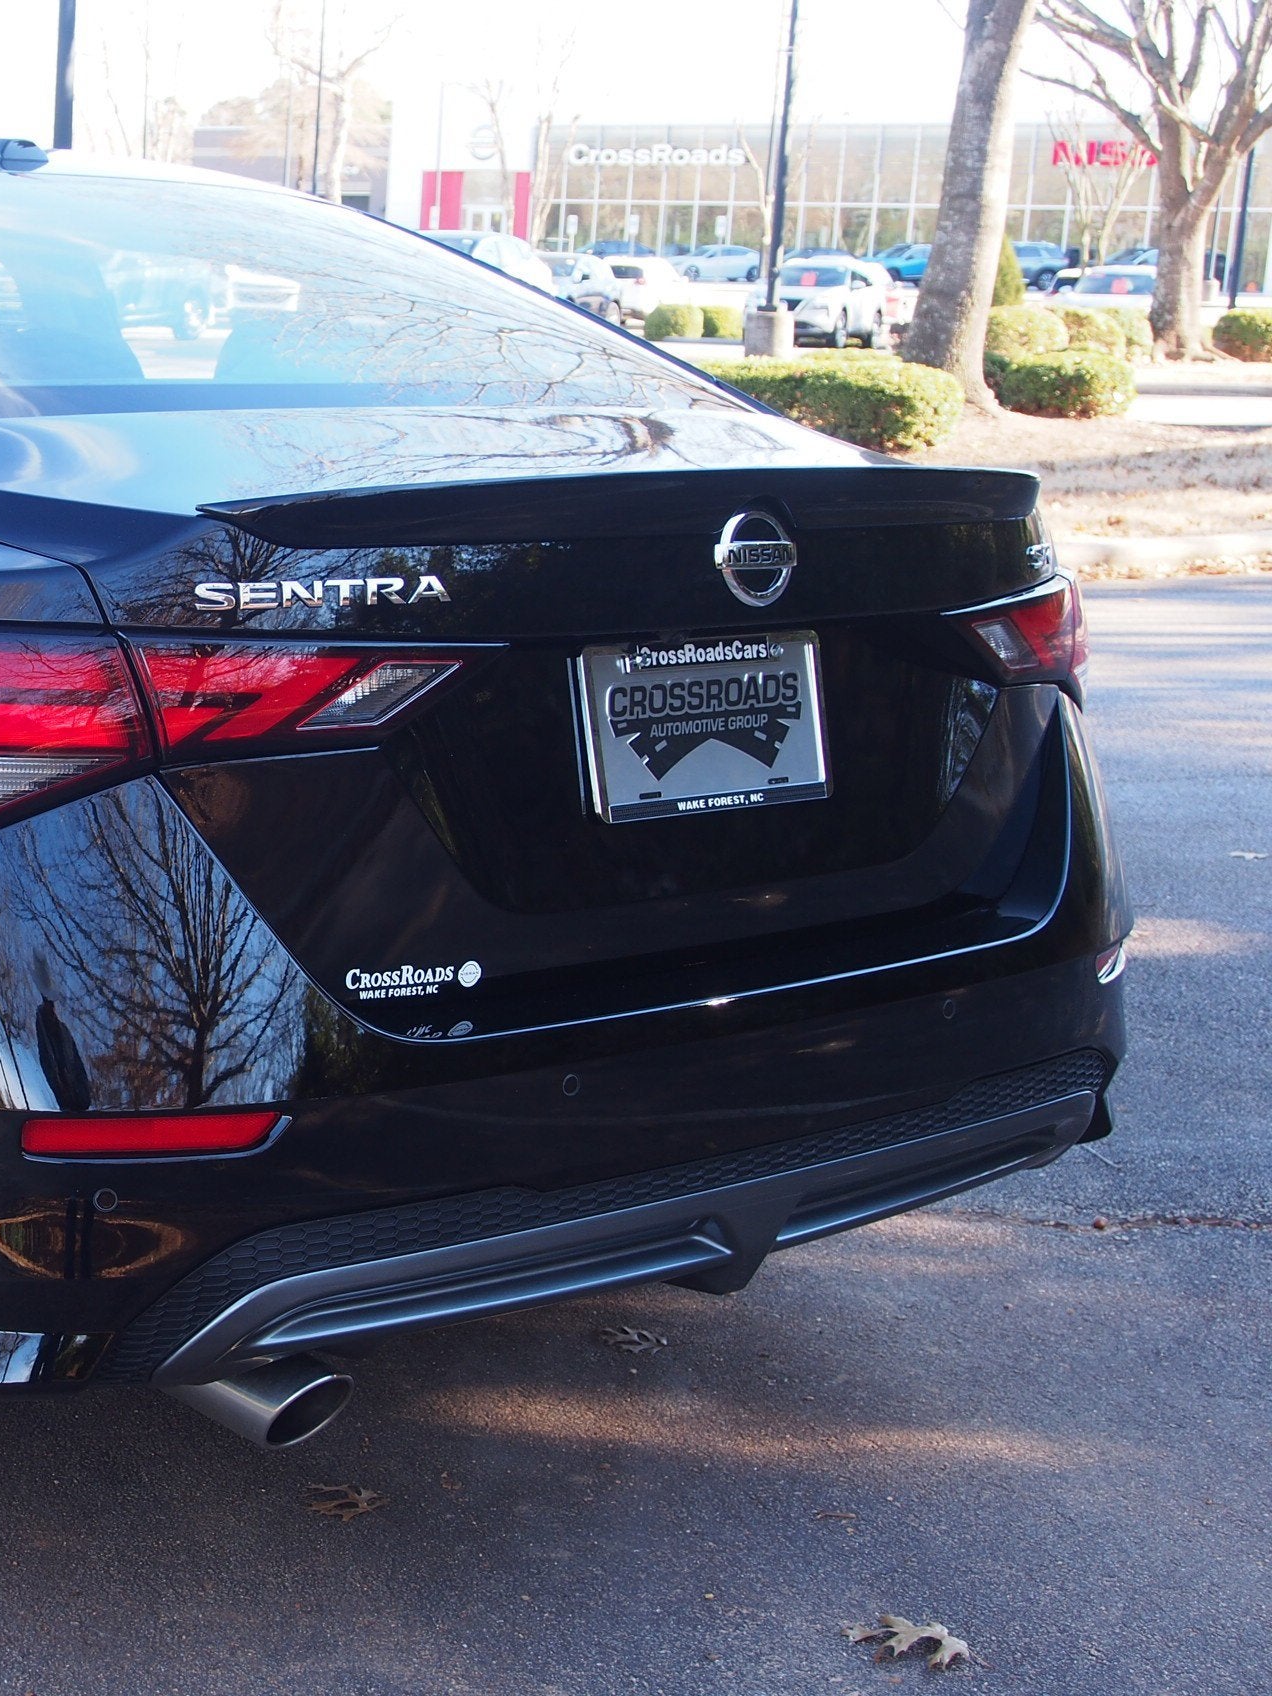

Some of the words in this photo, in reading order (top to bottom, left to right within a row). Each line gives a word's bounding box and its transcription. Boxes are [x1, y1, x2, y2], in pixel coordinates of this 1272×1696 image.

[568, 143, 746, 166] CrossRoads
[728, 547, 792, 565] NISSAN
[194, 575, 452, 611] SENTRA
[639, 640, 767, 668] CrossRoadsCars
[609, 672, 799, 719] CROSSROADS
[650, 717, 726, 738] AUTOMOTIVE
[728, 713, 768, 730] GROUP
[677, 799, 706, 811] WAKE
[708, 795, 748, 807] FOREST,
[750, 792, 764, 803] NC
[359, 989, 386, 1000] WAKE
[388, 985, 424, 998] FOREST,
[426, 984, 439, 995] NC
